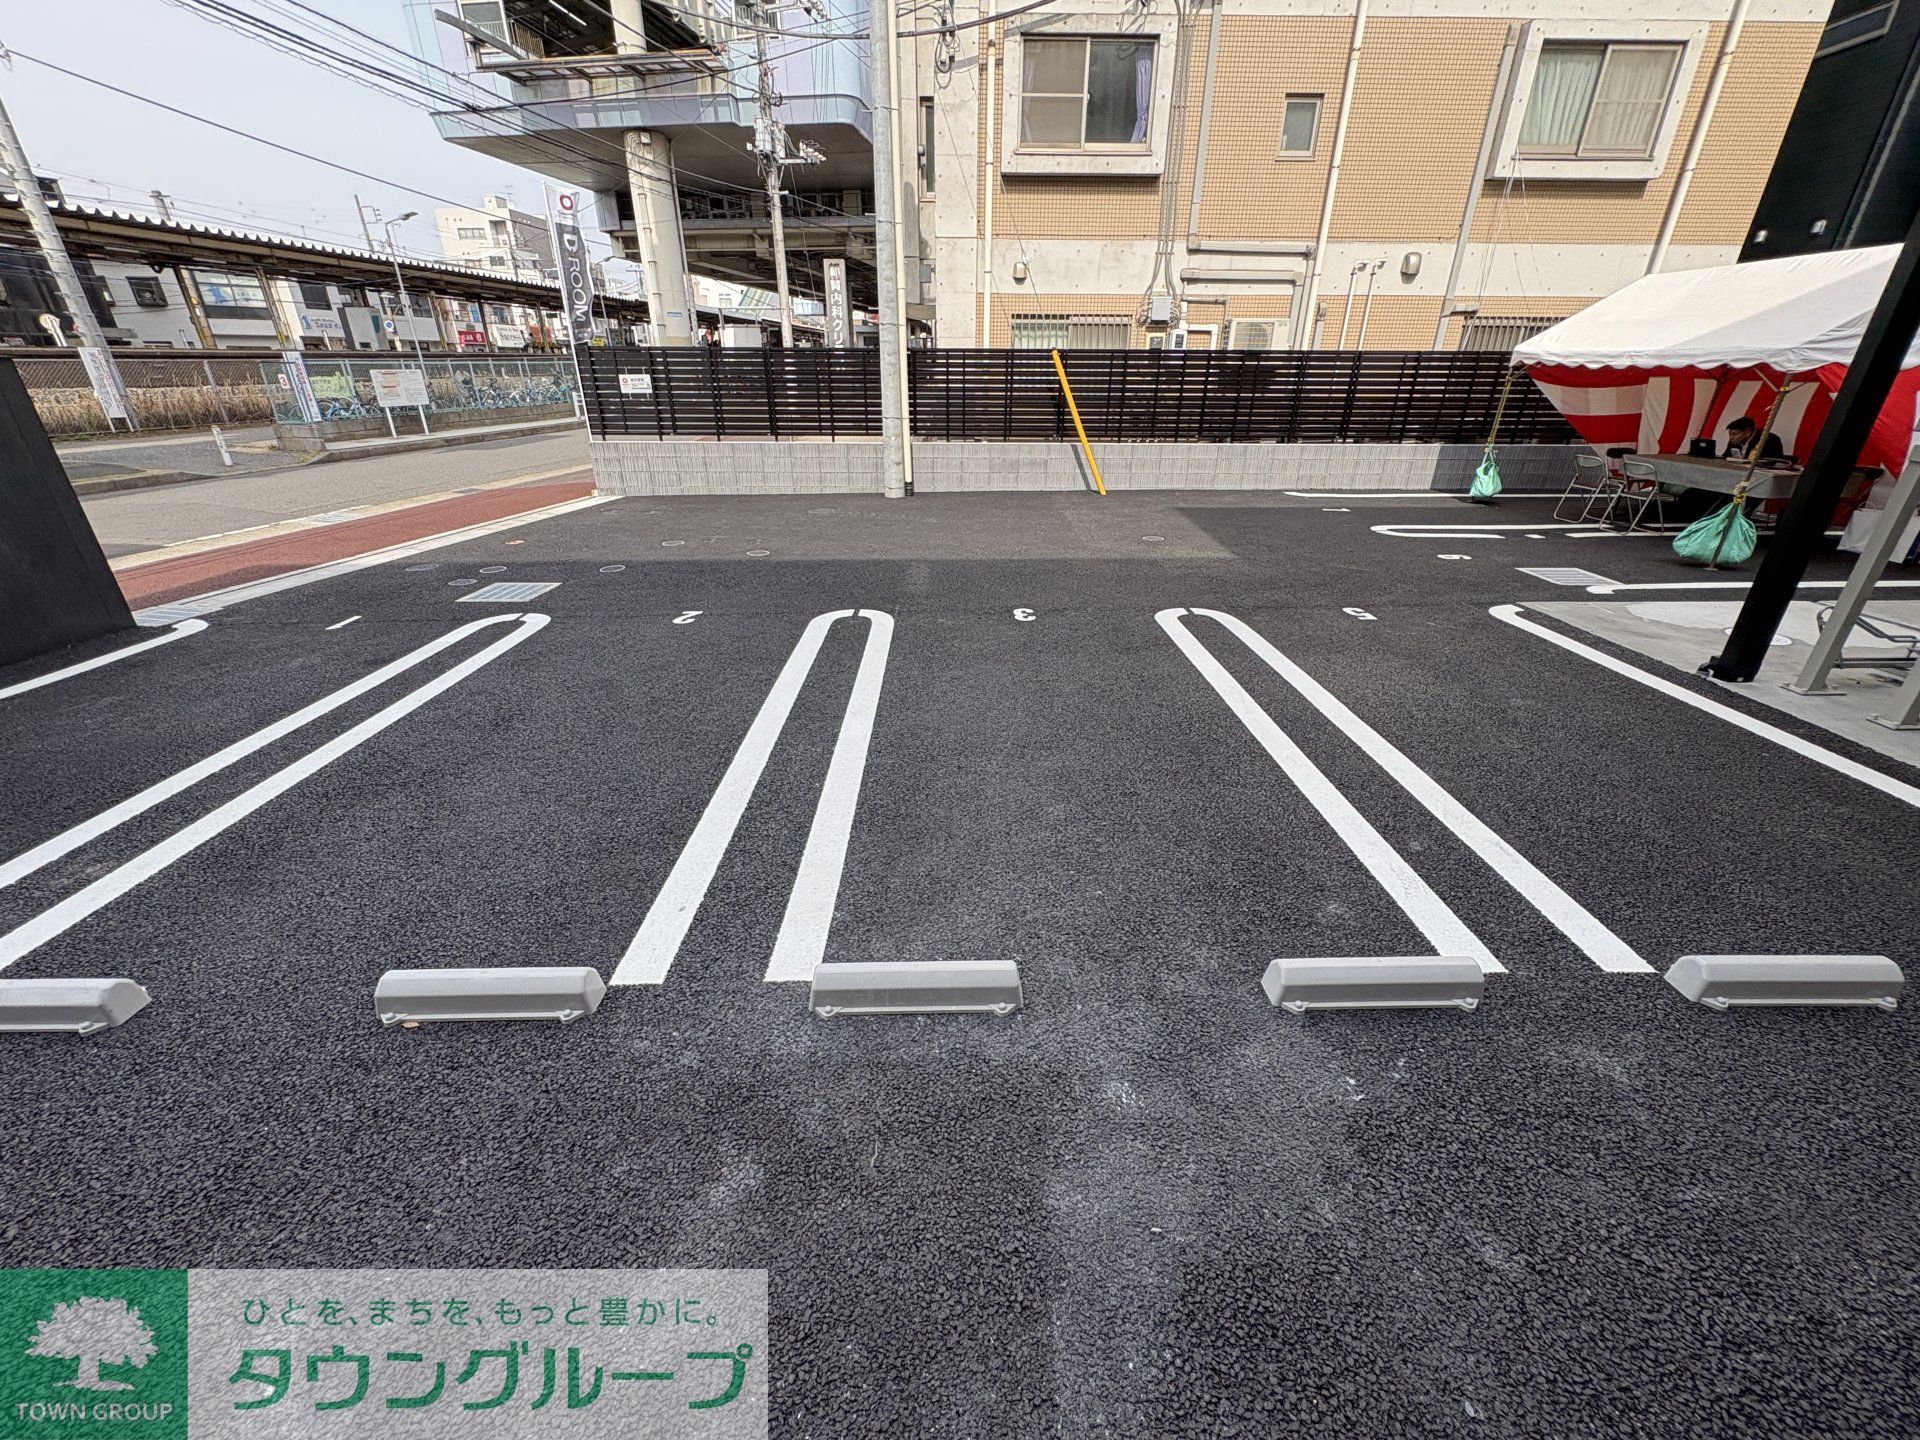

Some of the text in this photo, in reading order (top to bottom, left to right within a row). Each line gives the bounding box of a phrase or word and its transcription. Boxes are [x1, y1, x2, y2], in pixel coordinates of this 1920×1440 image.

[671, 610, 704, 625] 2
[1012, 607, 1037, 622] 3
[1342, 607, 1378, 621] 5
